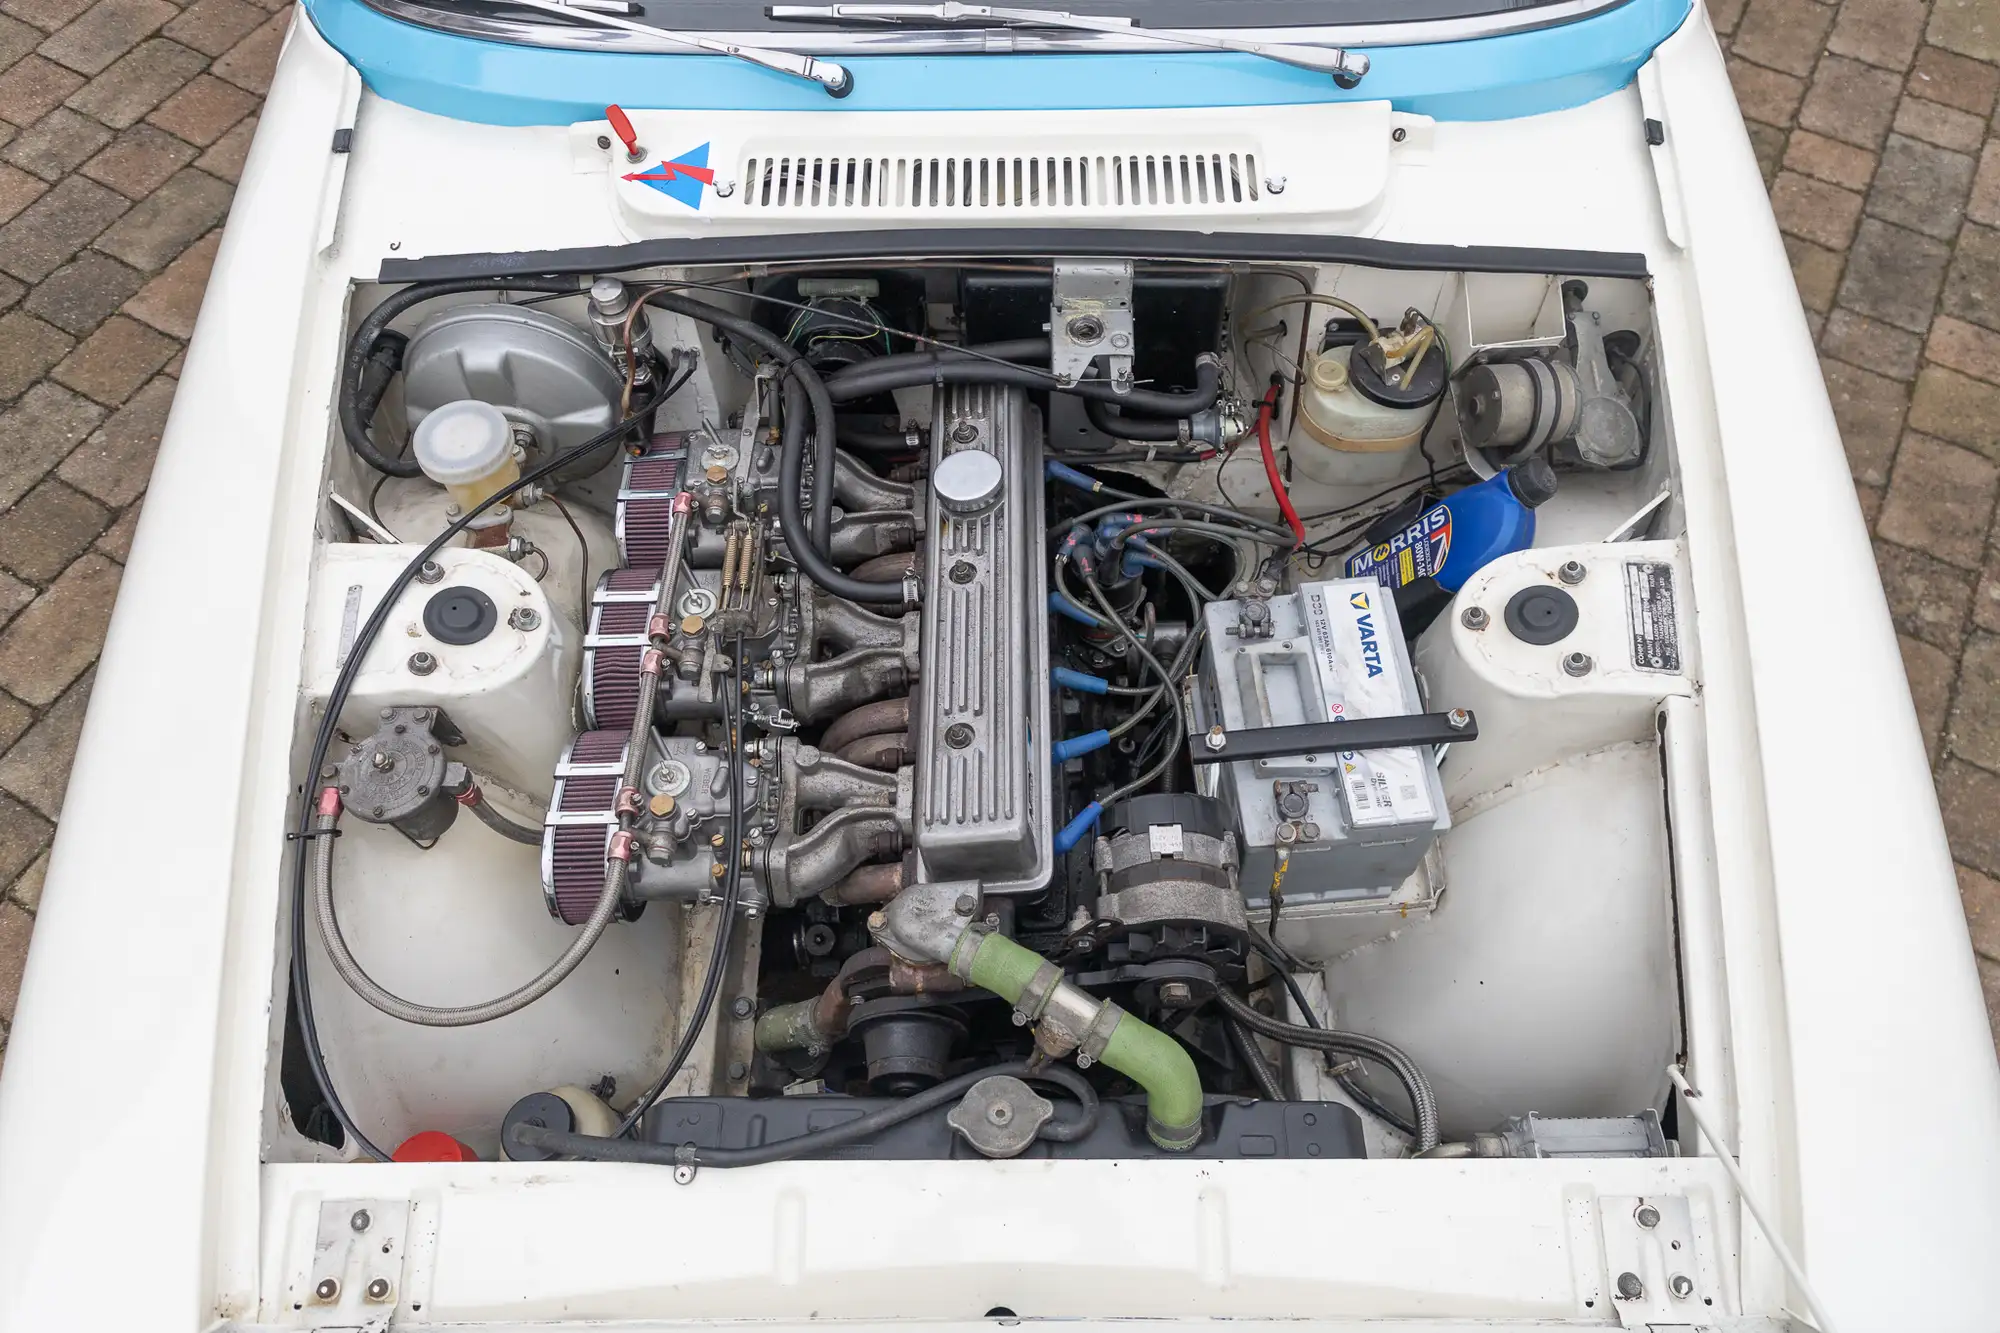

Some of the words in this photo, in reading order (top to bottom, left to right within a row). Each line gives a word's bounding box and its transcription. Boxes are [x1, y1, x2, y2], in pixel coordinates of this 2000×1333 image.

[1356, 613, 1383, 678] VARTA
[701, 768, 712, 795] WEBER
[1376, 772, 1392, 807] SILVER
